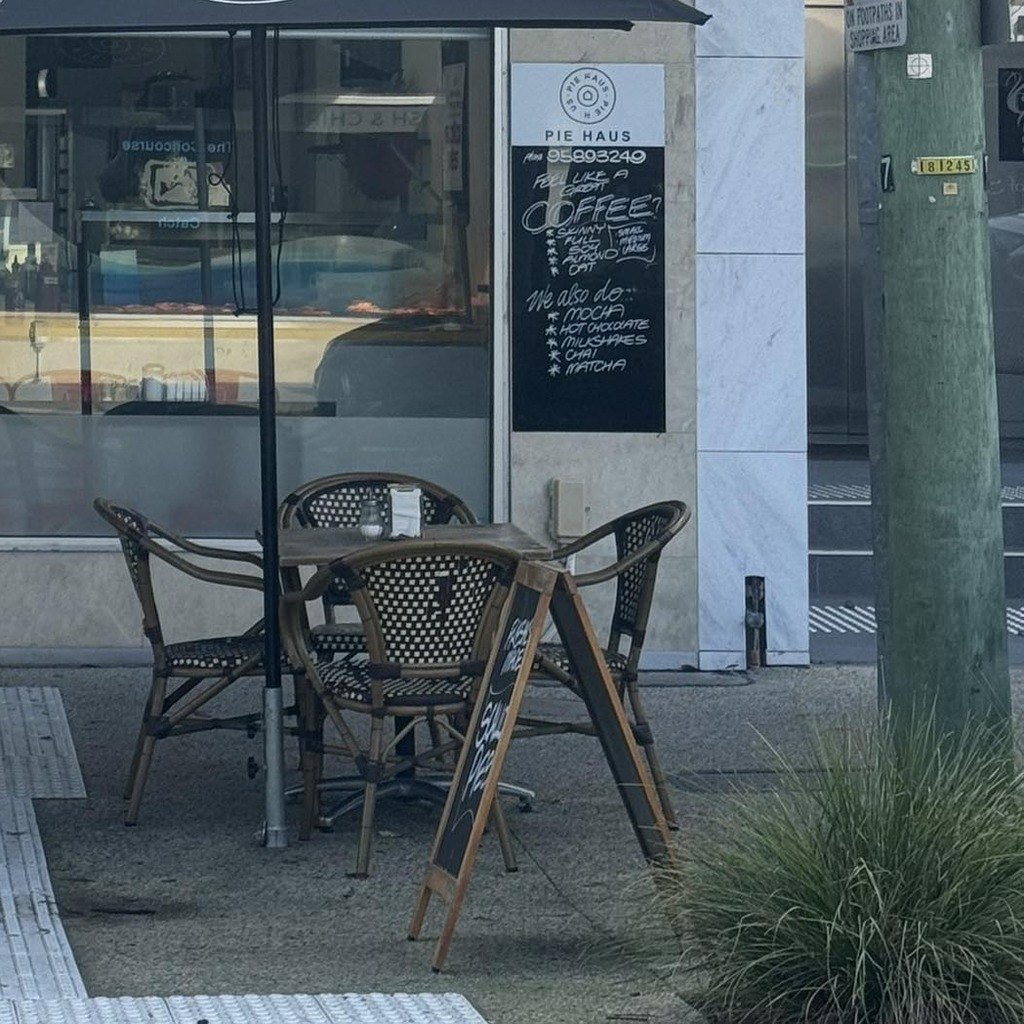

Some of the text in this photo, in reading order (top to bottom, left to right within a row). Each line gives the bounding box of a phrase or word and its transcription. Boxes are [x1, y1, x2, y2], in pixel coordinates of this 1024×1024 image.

[545, 130, 631, 142] PIE HAUS
[533, 169, 628, 189] FEEL LIKE A
[526, 283, 554, 312] We
[557, 282, 590, 307] also
[563, 304, 625, 322] MOCHA
[559, 323, 587, 335] HOT
[560, 334, 648, 349] MILKSHAKES
[565, 348, 597, 361] CHAI
[566, 358, 627, 375] MATCHA
